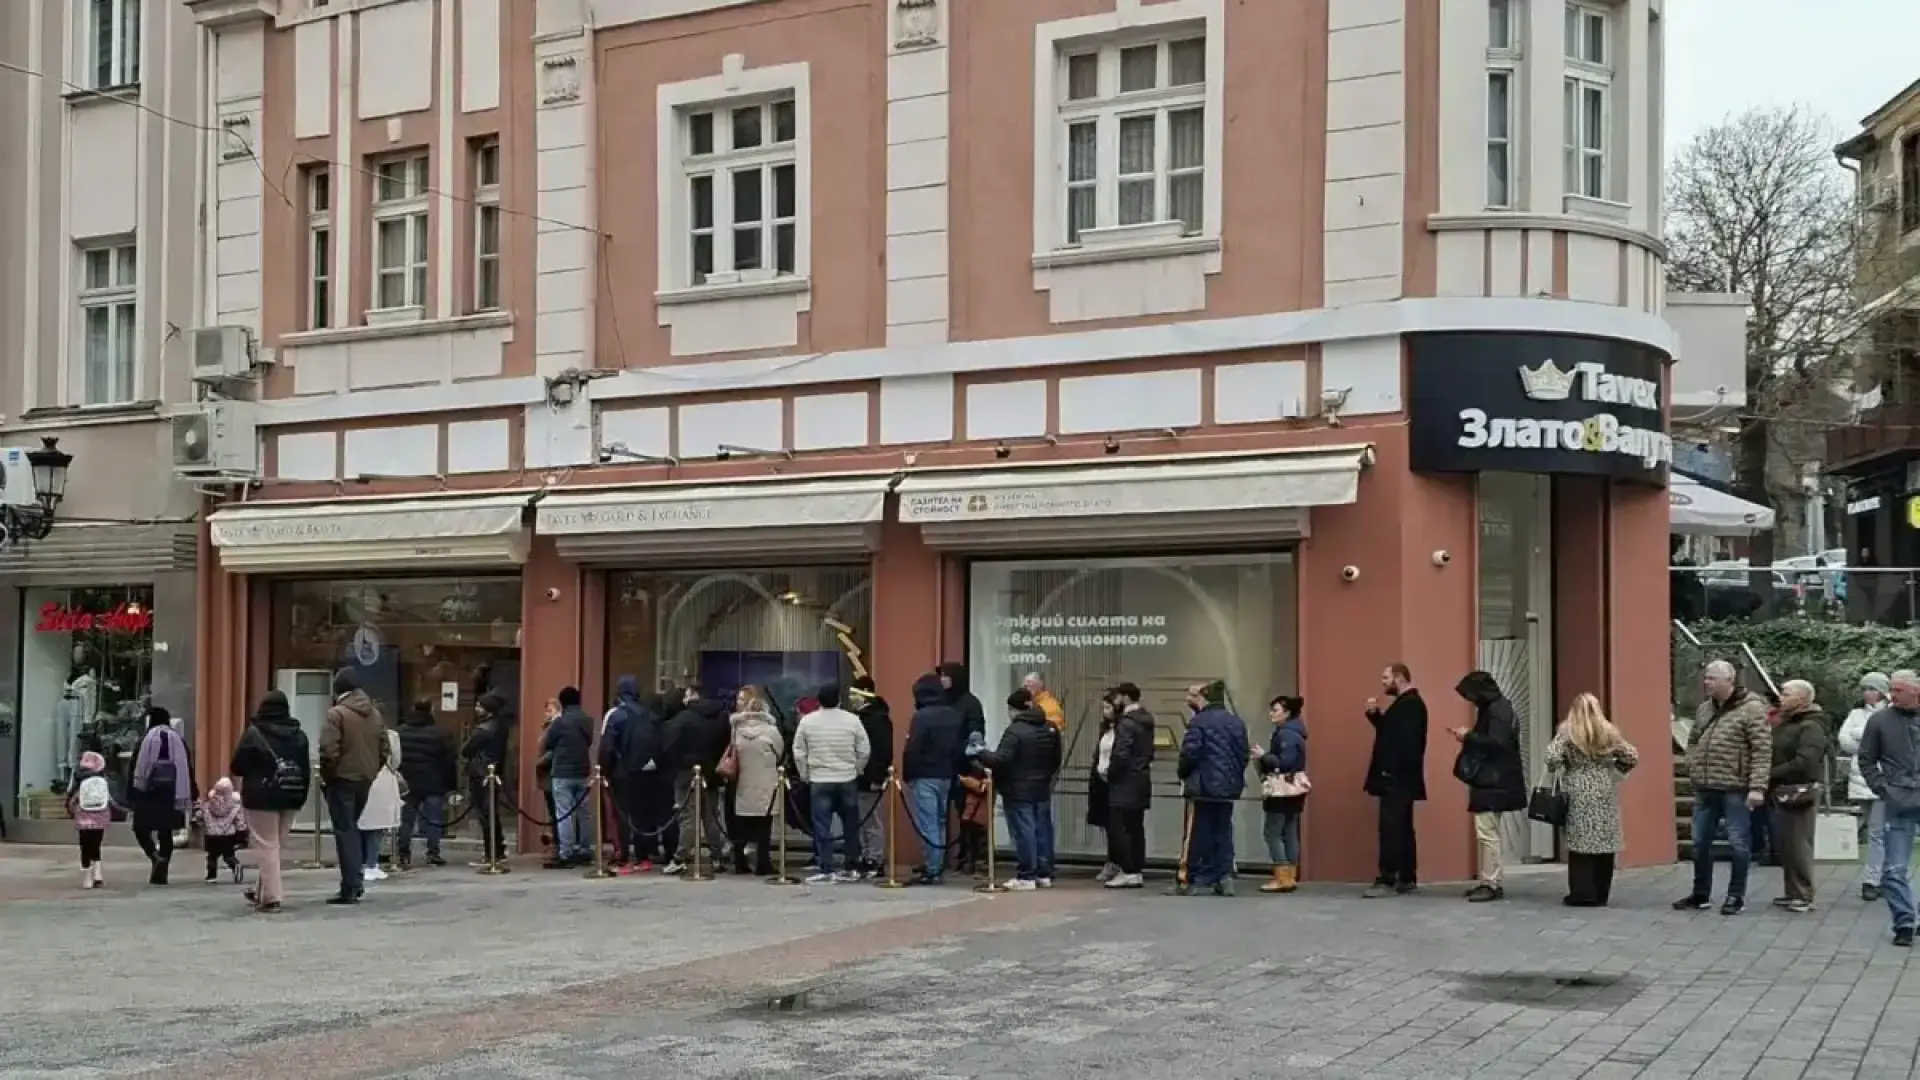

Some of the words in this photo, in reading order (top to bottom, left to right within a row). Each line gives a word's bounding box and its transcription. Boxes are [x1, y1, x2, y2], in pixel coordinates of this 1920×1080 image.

[1577, 362, 1657, 410] Tavex
[996, 612, 1064, 630] ткрий
[1067, 615, 1138, 628] силата
[1142, 615, 1165, 627] на
[996, 632, 1168, 648] вестиционното
[1001, 652, 1051, 664] ато.
